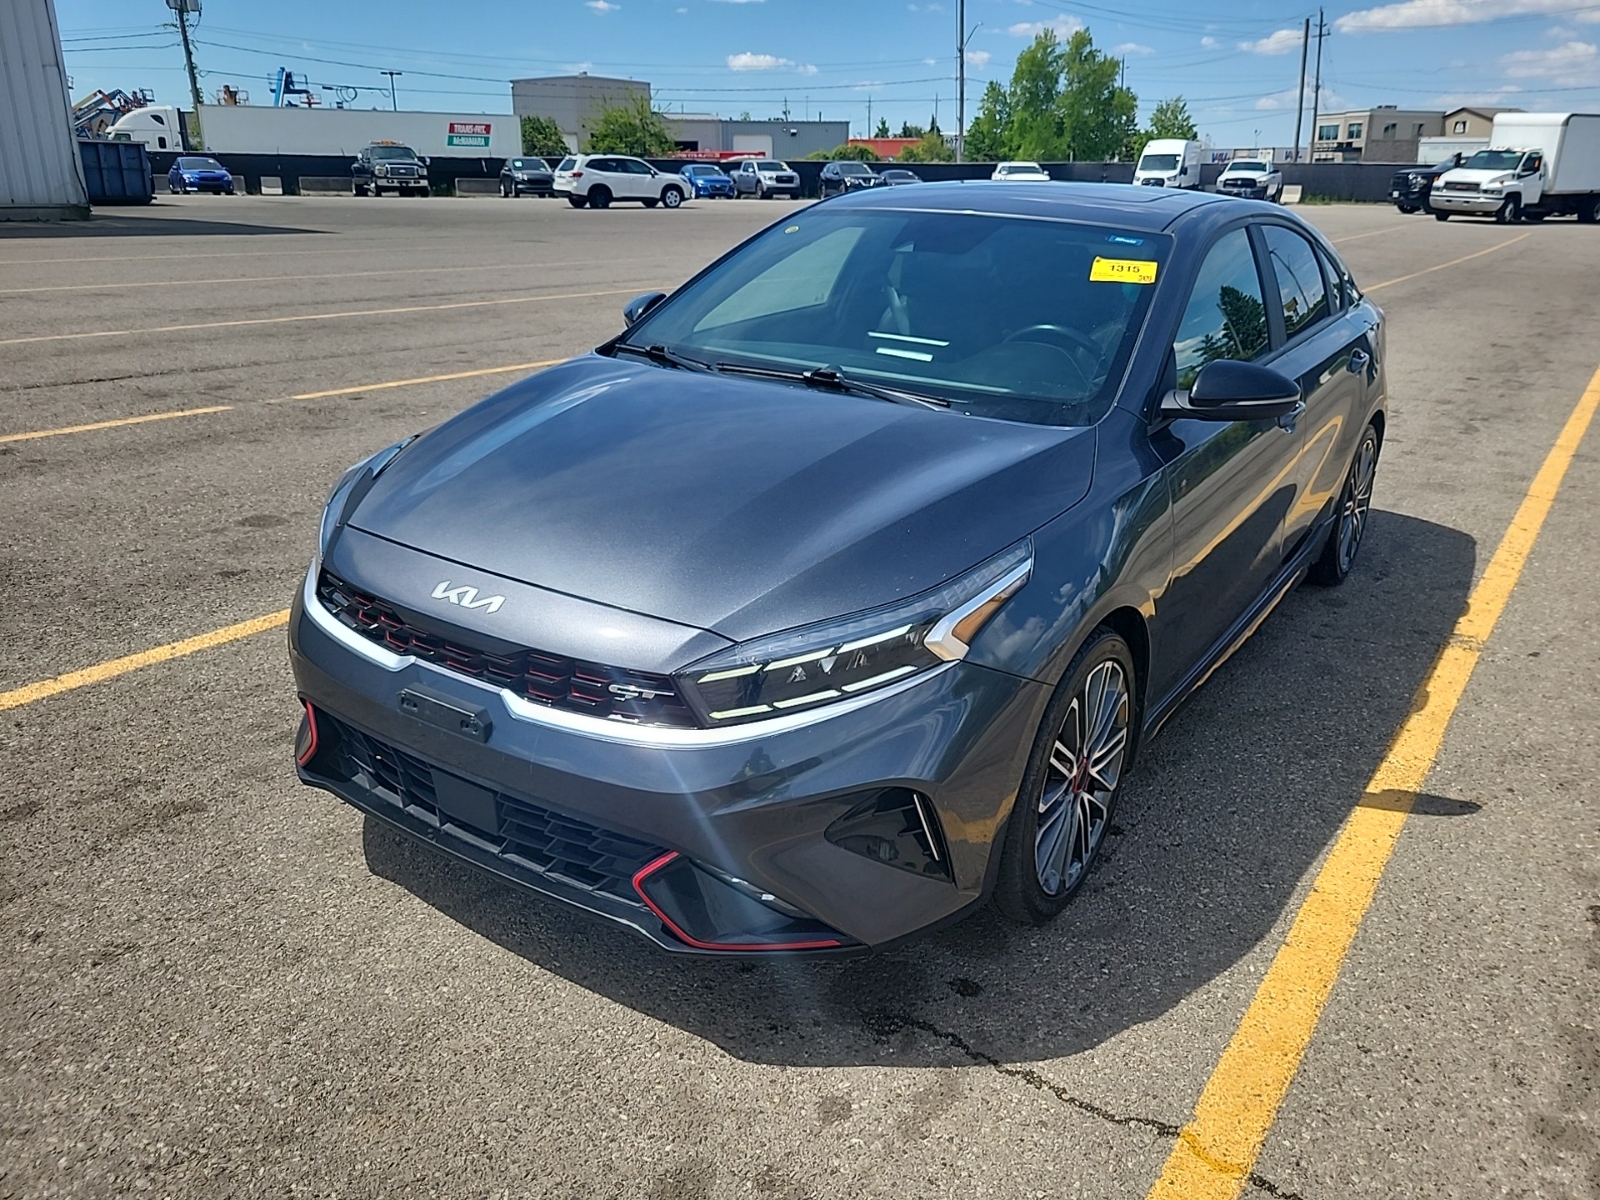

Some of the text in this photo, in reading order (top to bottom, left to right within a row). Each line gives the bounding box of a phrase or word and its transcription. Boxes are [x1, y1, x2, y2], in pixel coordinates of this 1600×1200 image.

[1109, 264, 1141, 273] 1315
[430, 580, 506, 614] KIA
[608, 684, 675, 702] GT
